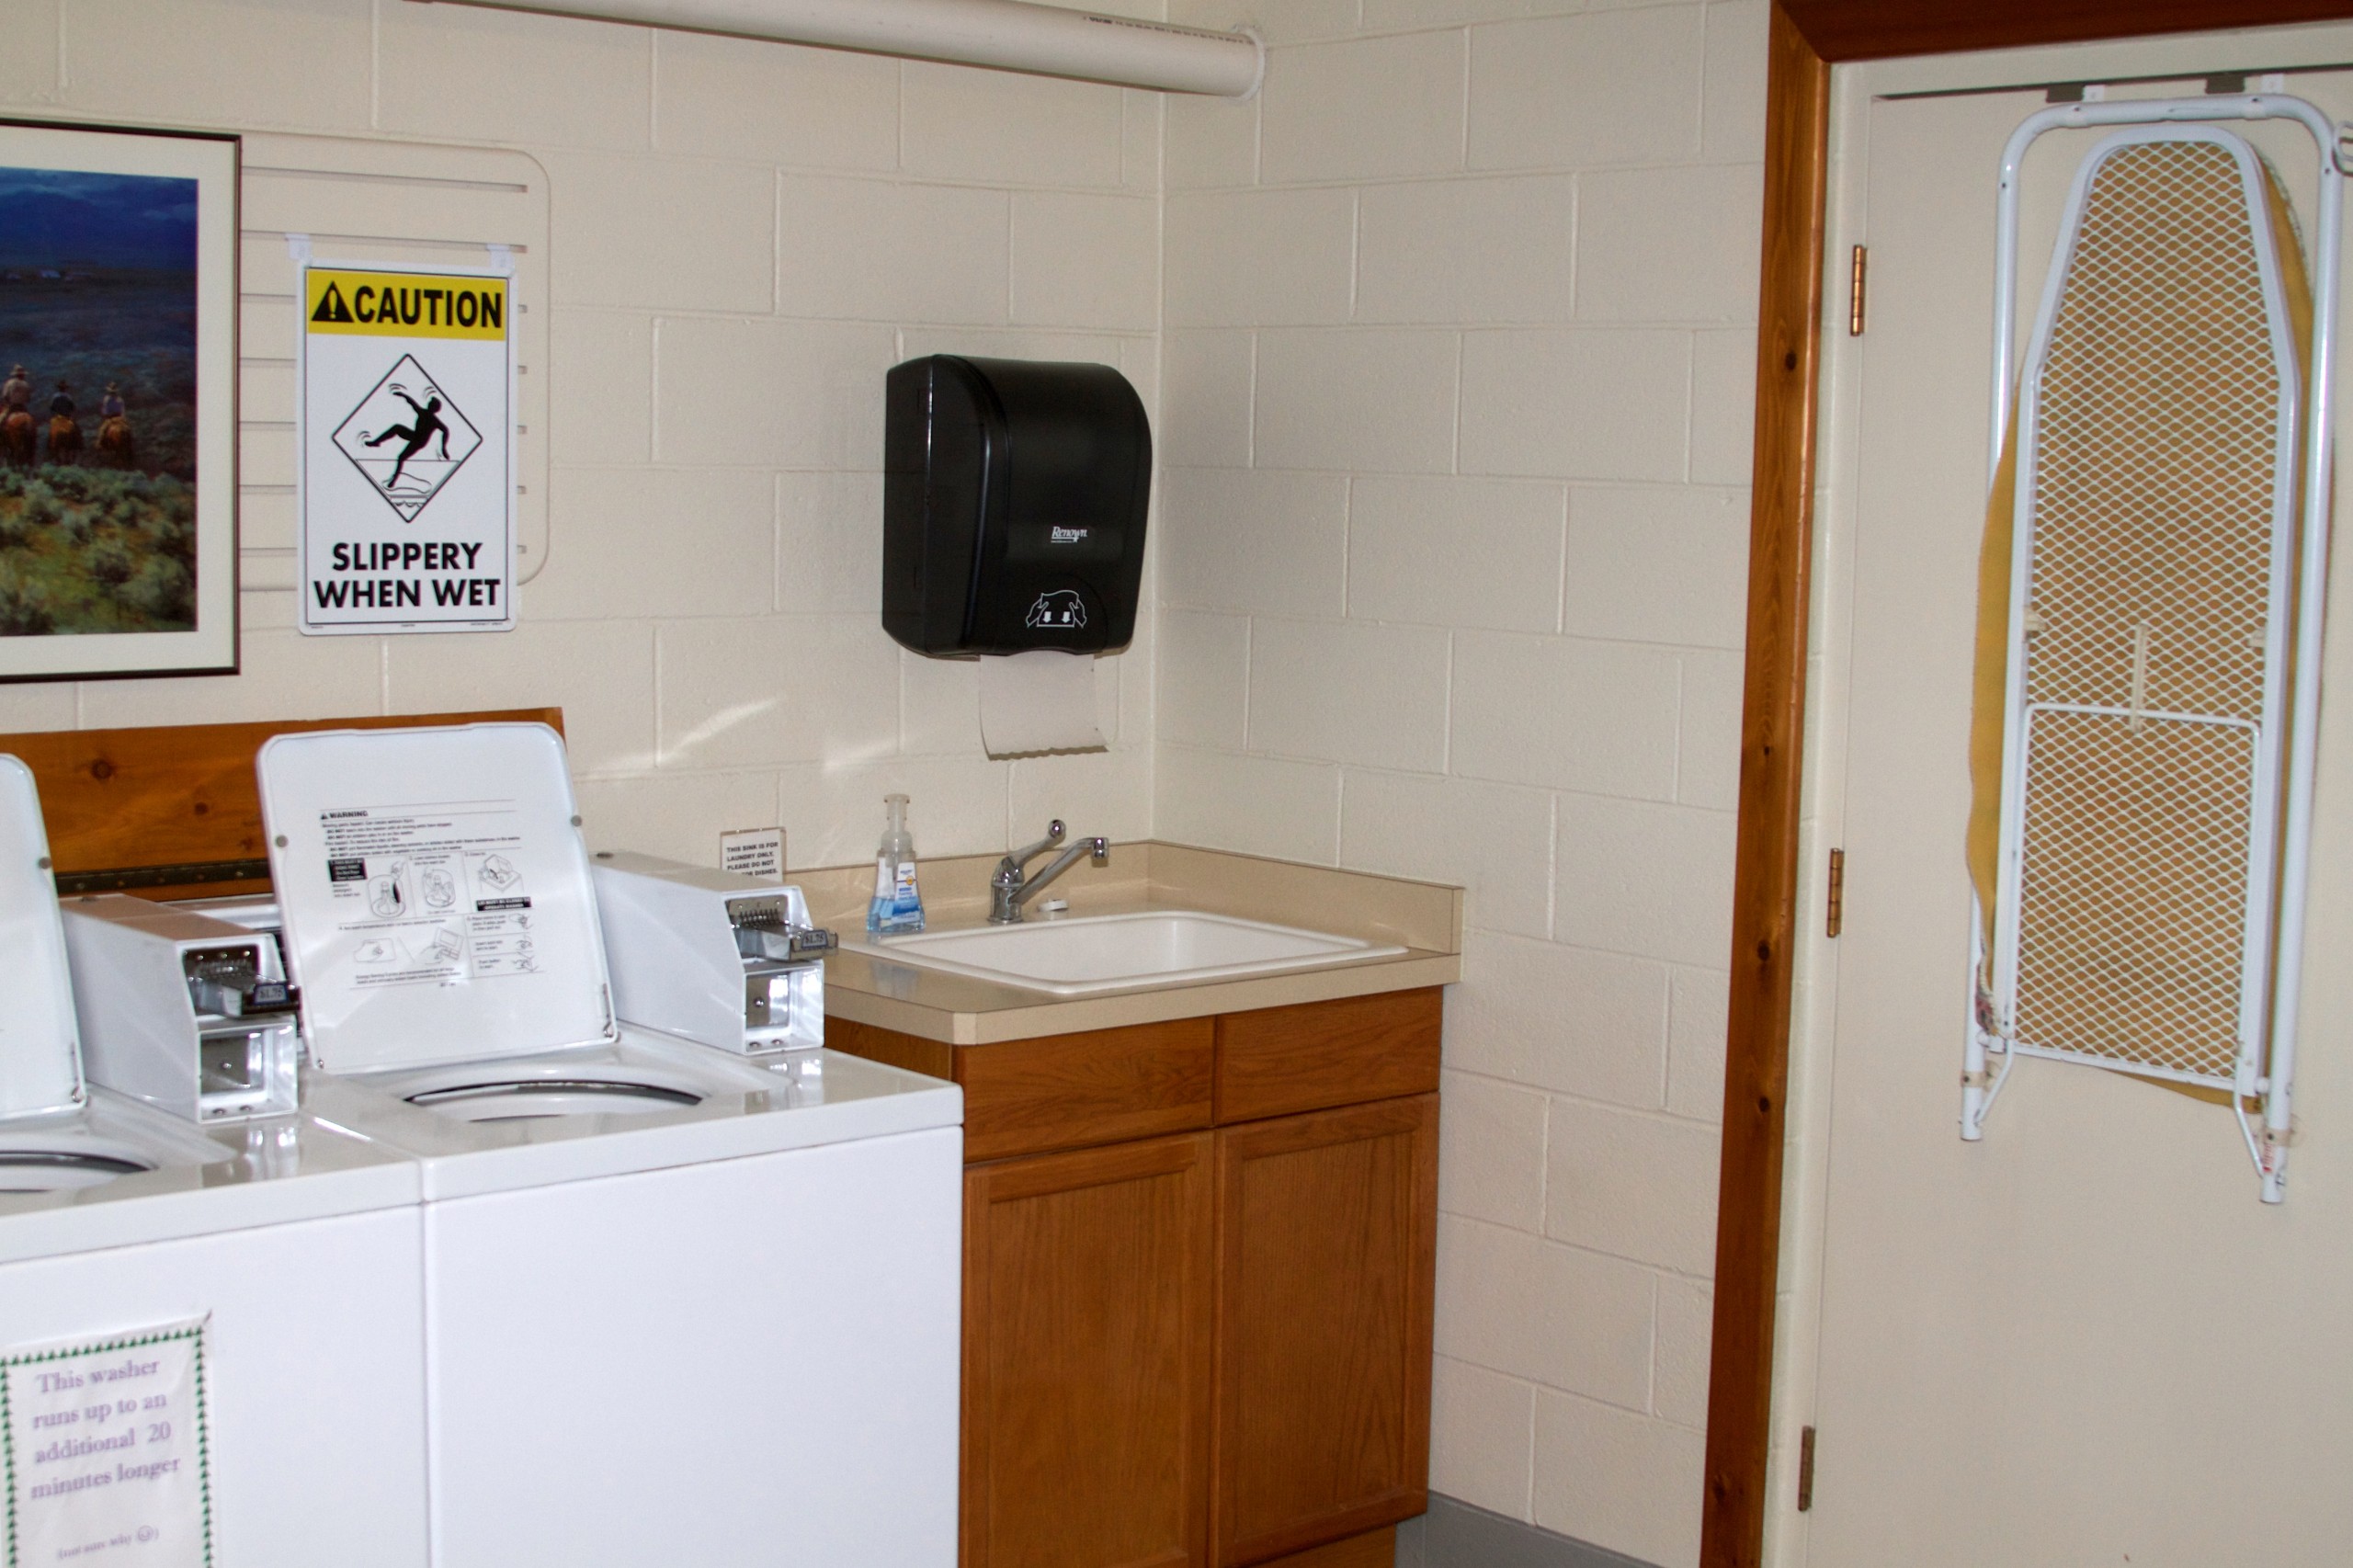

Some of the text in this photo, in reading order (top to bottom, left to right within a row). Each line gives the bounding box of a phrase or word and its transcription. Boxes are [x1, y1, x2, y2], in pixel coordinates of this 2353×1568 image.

[354, 285, 502, 328] CAUTION
[1051, 526, 1087, 538] Renown
[333, 541, 483, 571] SLIPPERY
[313, 578, 501, 608] WHEN WET
[329, 810, 369, 819] WARNING
[805, 933, 824, 944] $1.75
[37, 1358, 160, 1393] This washer
[32, 1393, 167, 1430] runs up to an
[35, 1420, 172, 1464] additional 20
[30, 1456, 181, 1500] minutes longer
[109, 1533, 132, 1546] why
